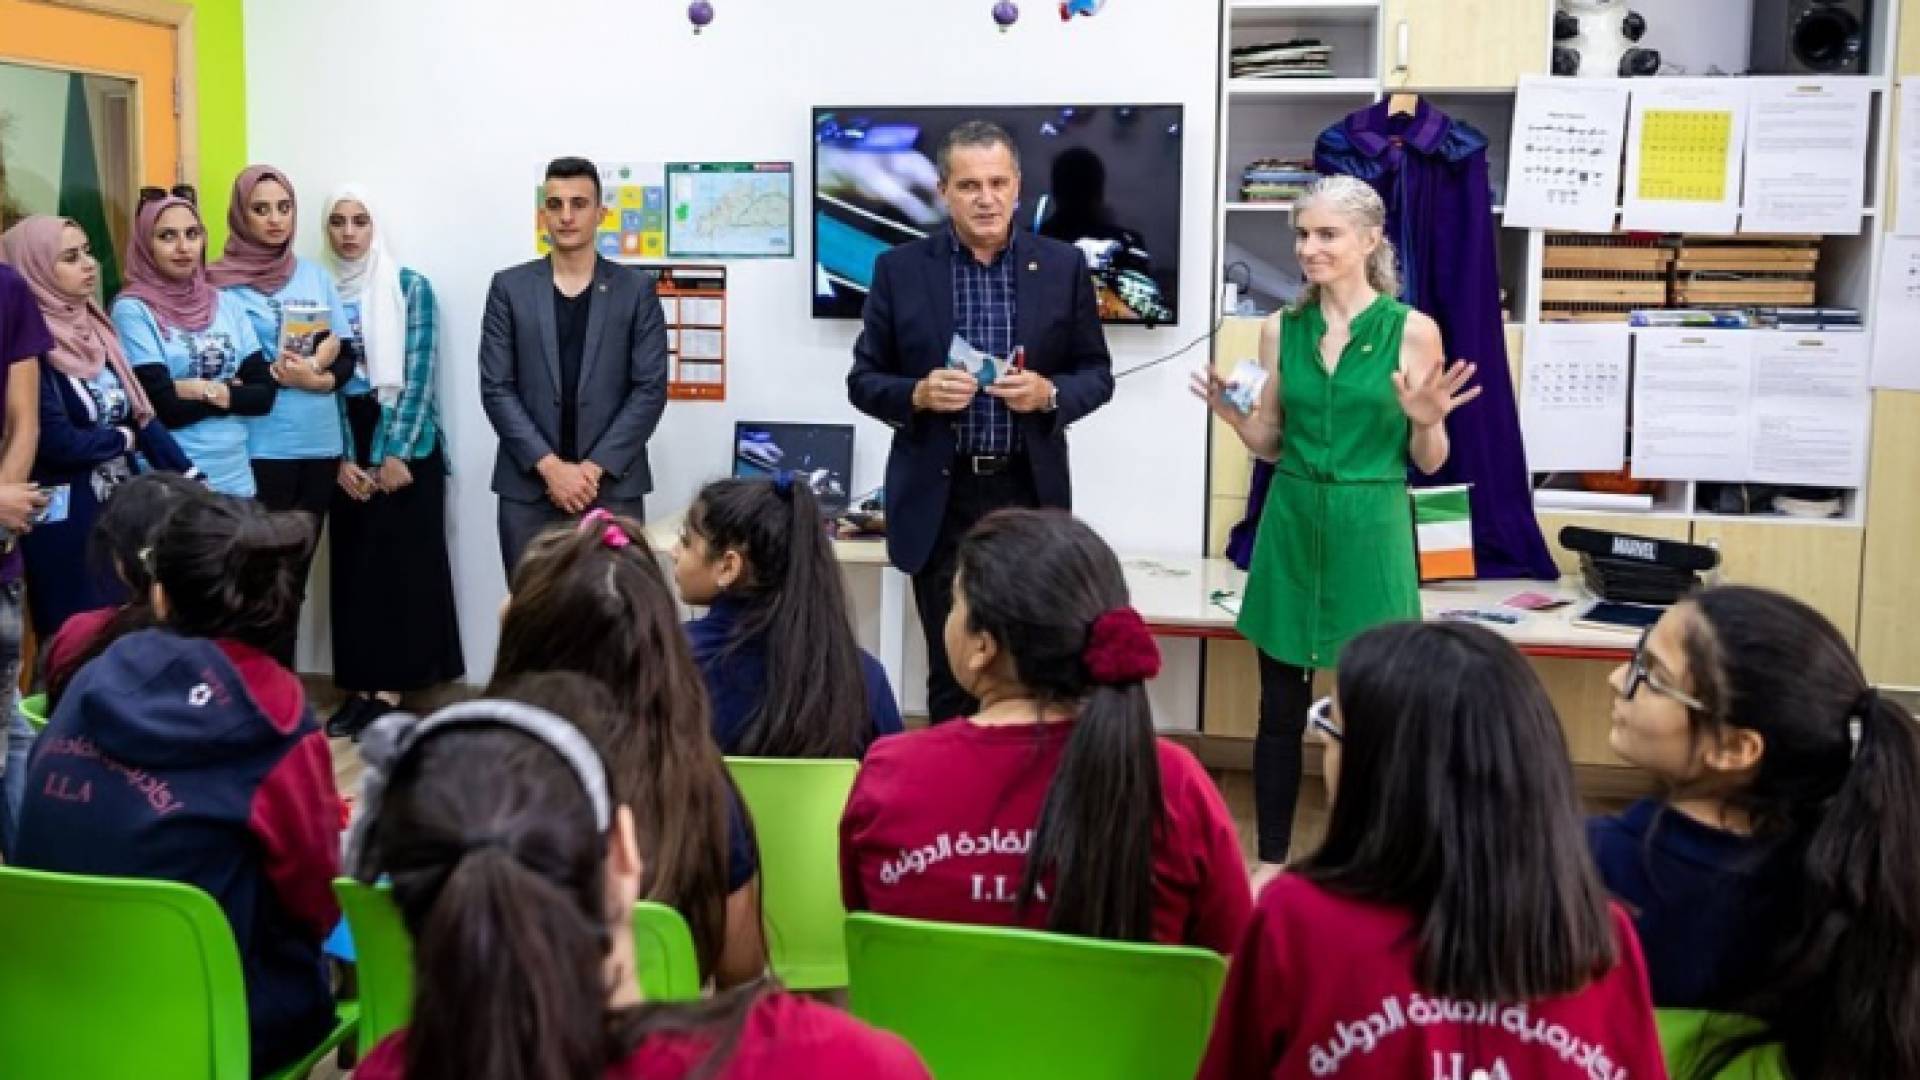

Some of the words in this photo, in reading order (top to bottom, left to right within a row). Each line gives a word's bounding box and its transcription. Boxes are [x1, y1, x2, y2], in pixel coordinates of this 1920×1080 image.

[1611, 536, 1656, 560] MARVEL
[955, 827, 1034, 855] لقادة
[881, 833, 951, 883] الدولية
[1309, 997, 1407, 1077] الدولية
[1432, 1049, 1511, 1080] I.LA
